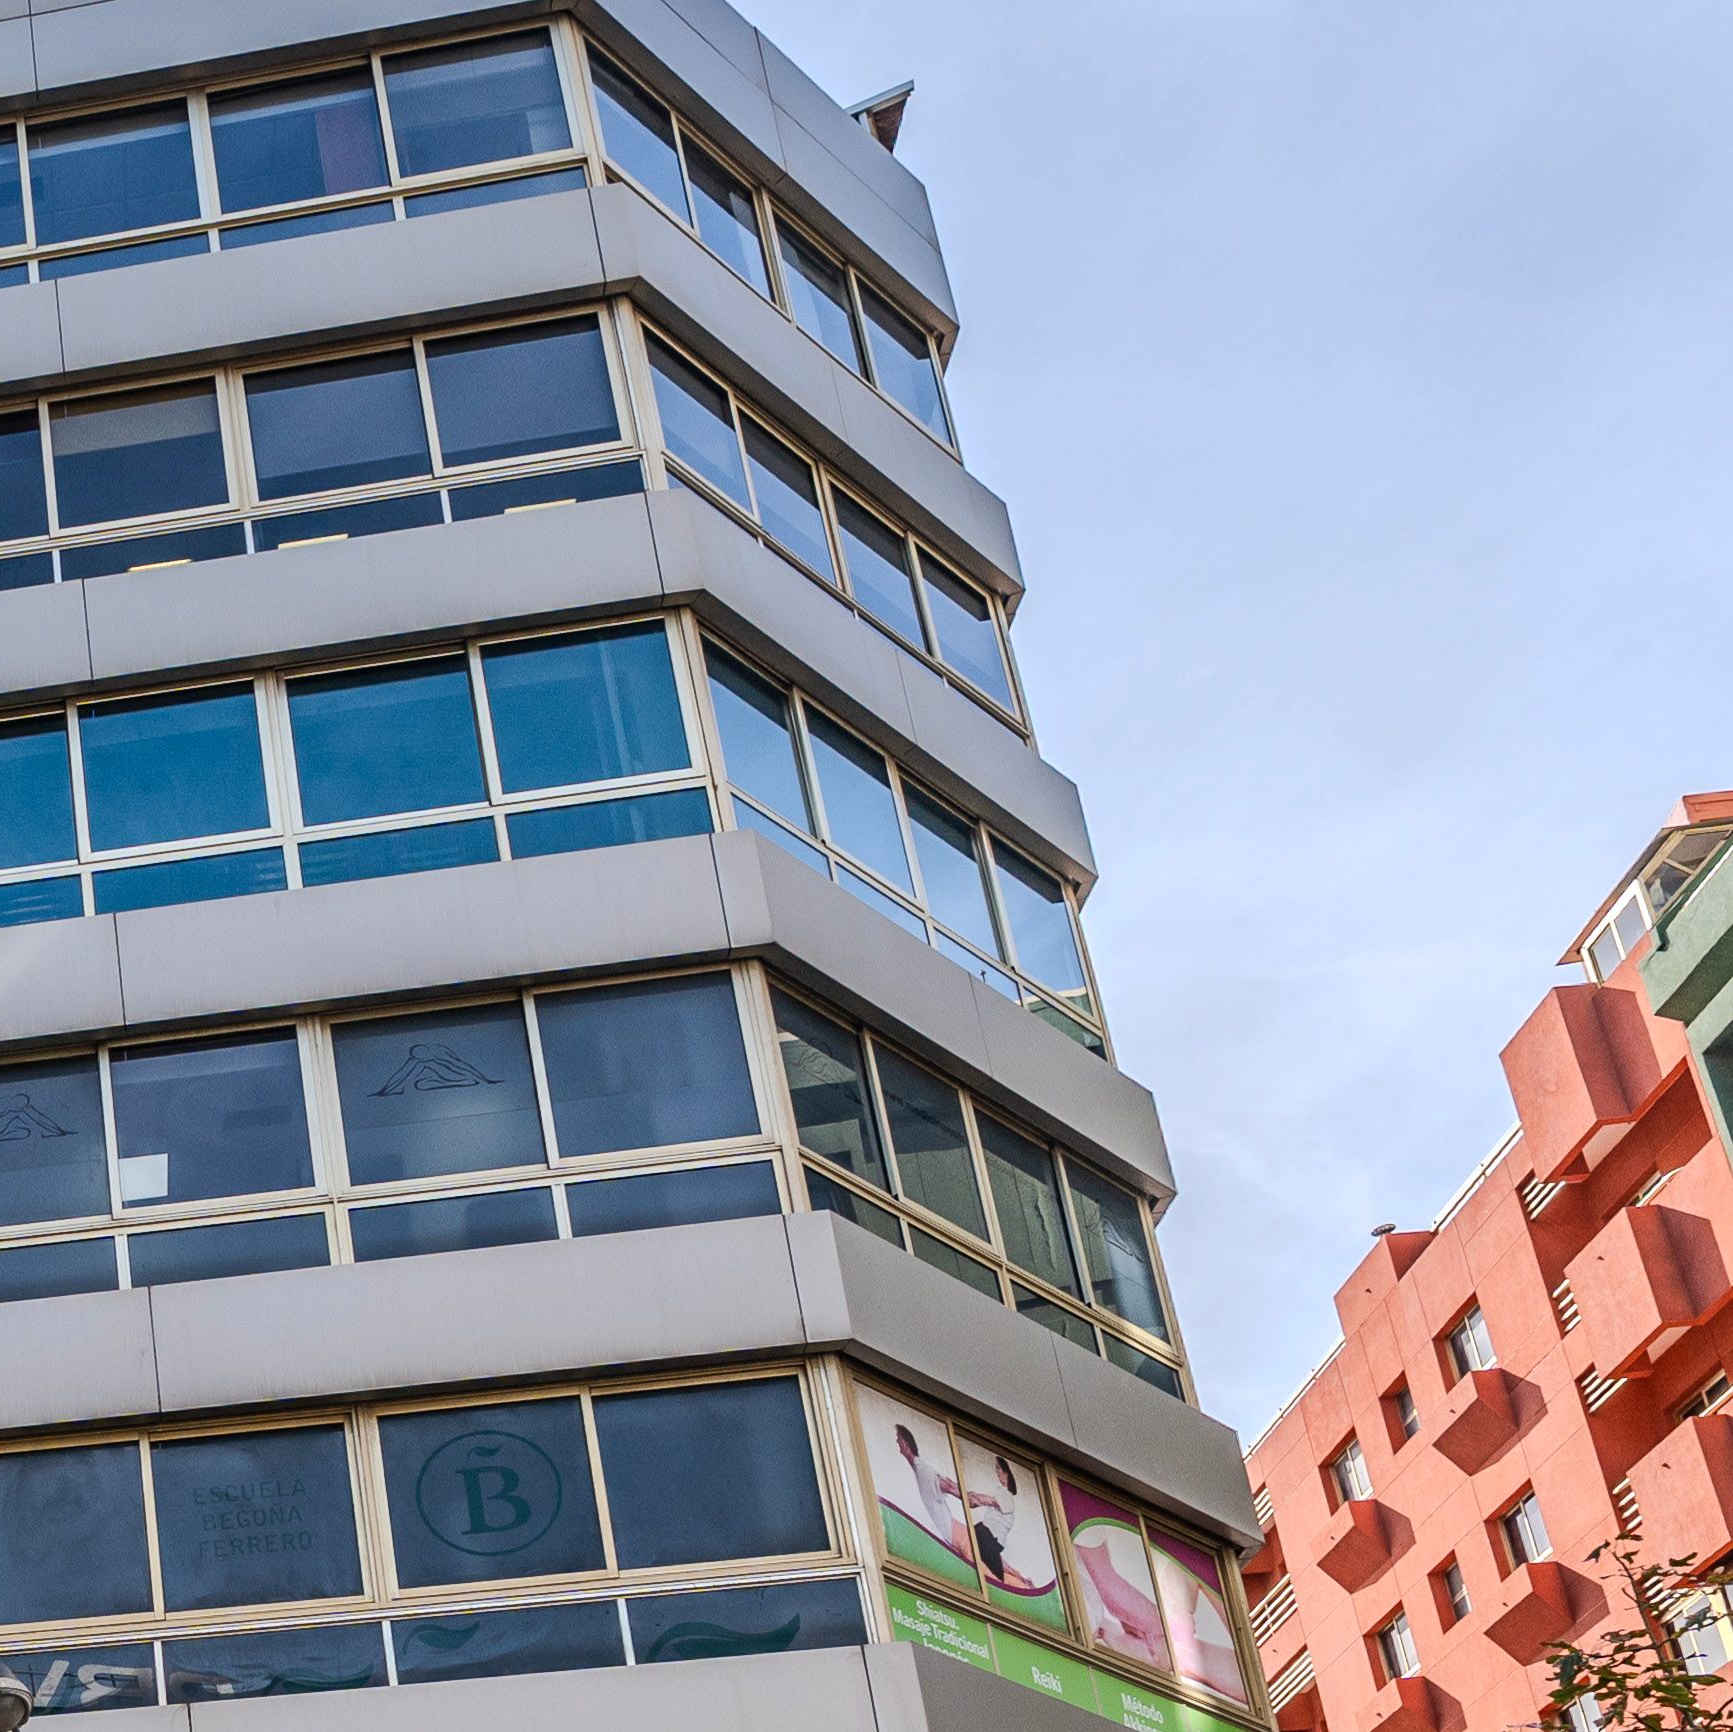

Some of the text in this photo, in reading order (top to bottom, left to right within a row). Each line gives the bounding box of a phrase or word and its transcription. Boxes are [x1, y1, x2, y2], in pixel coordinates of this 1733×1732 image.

[193, 1478, 307, 1505] ESCUELA
[199, 1531, 312, 1559] FERRERO
[893, 1607, 932, 1637] Masaje
[931, 1623, 989, 1660] Tradicional
[1031, 1666, 1063, 1694] Reiki
[1121, 1693, 1164, 1724] Método
